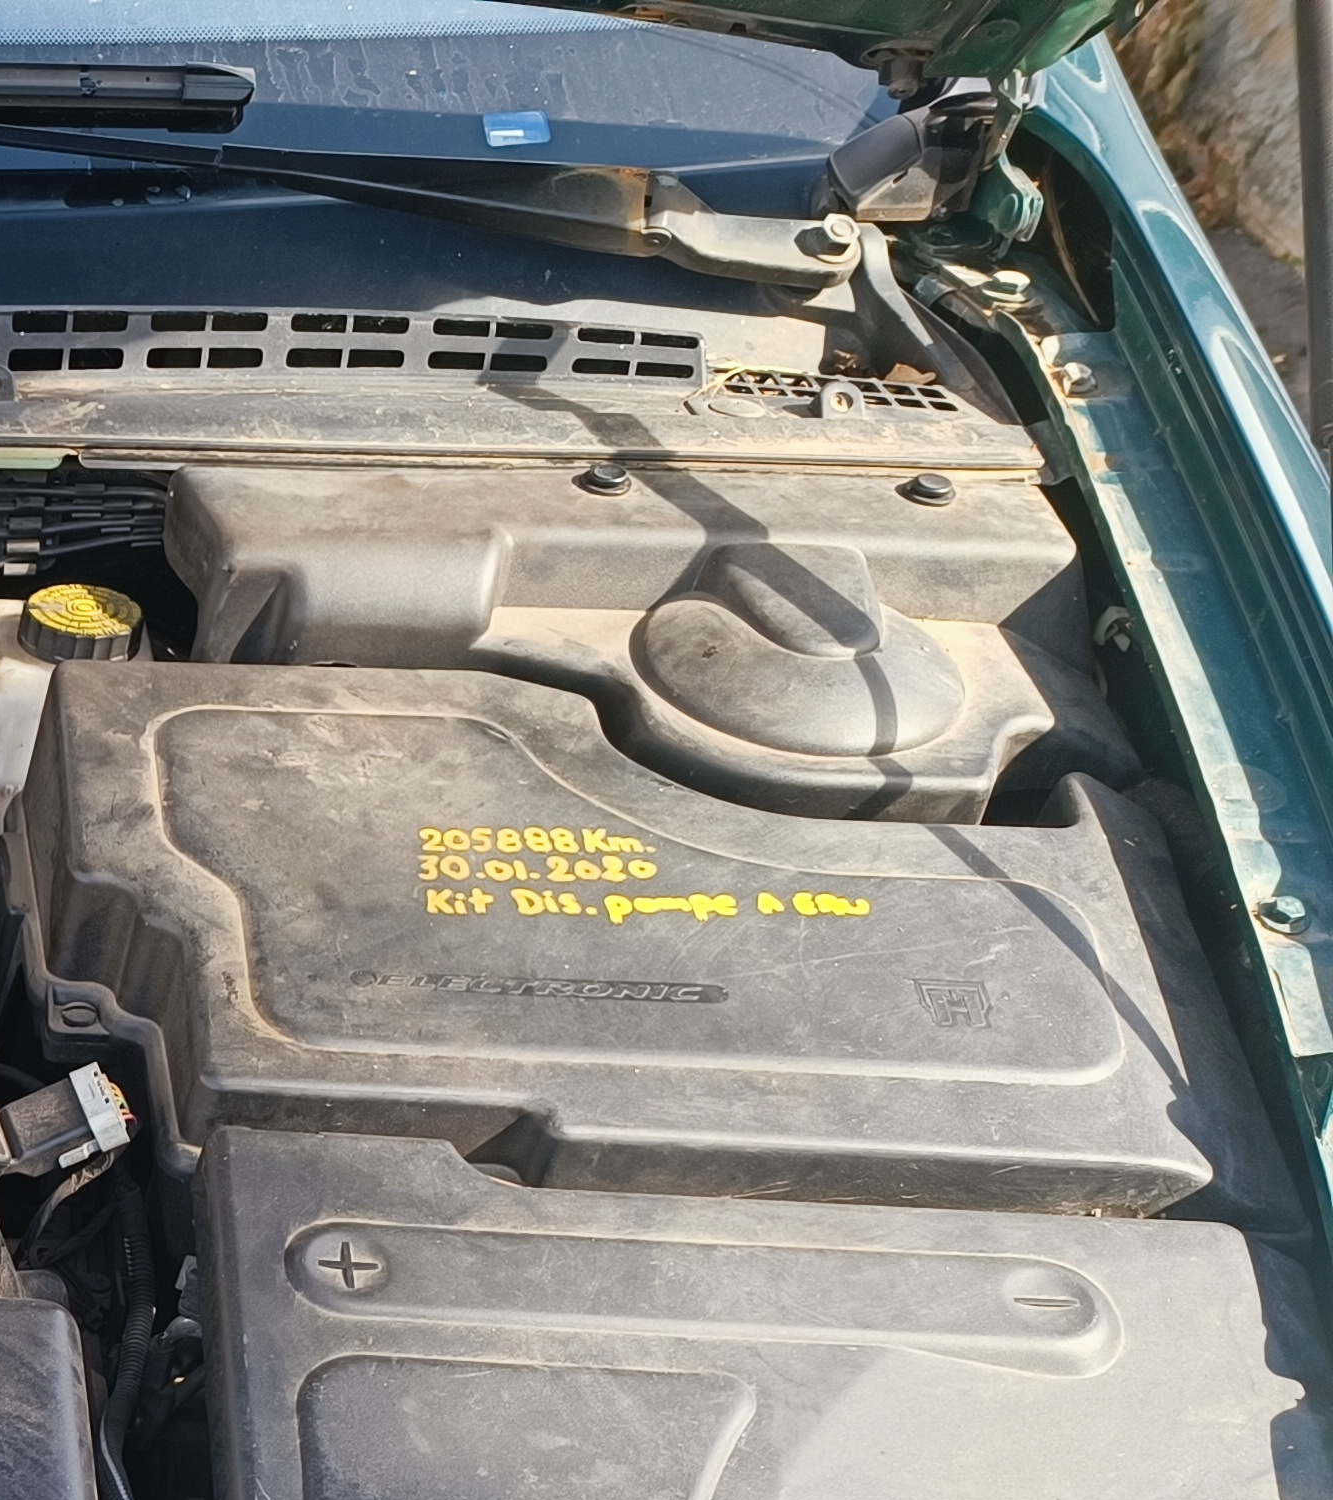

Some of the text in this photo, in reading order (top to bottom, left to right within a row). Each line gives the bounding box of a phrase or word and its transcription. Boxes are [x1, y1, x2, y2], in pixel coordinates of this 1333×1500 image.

[417, 854, 658, 883] 30.01.2020
[426, 886, 494, 915] Kit
[510, 887, 598, 916] Dis.
[376, 974, 702, 1001] ELECTRONIC
